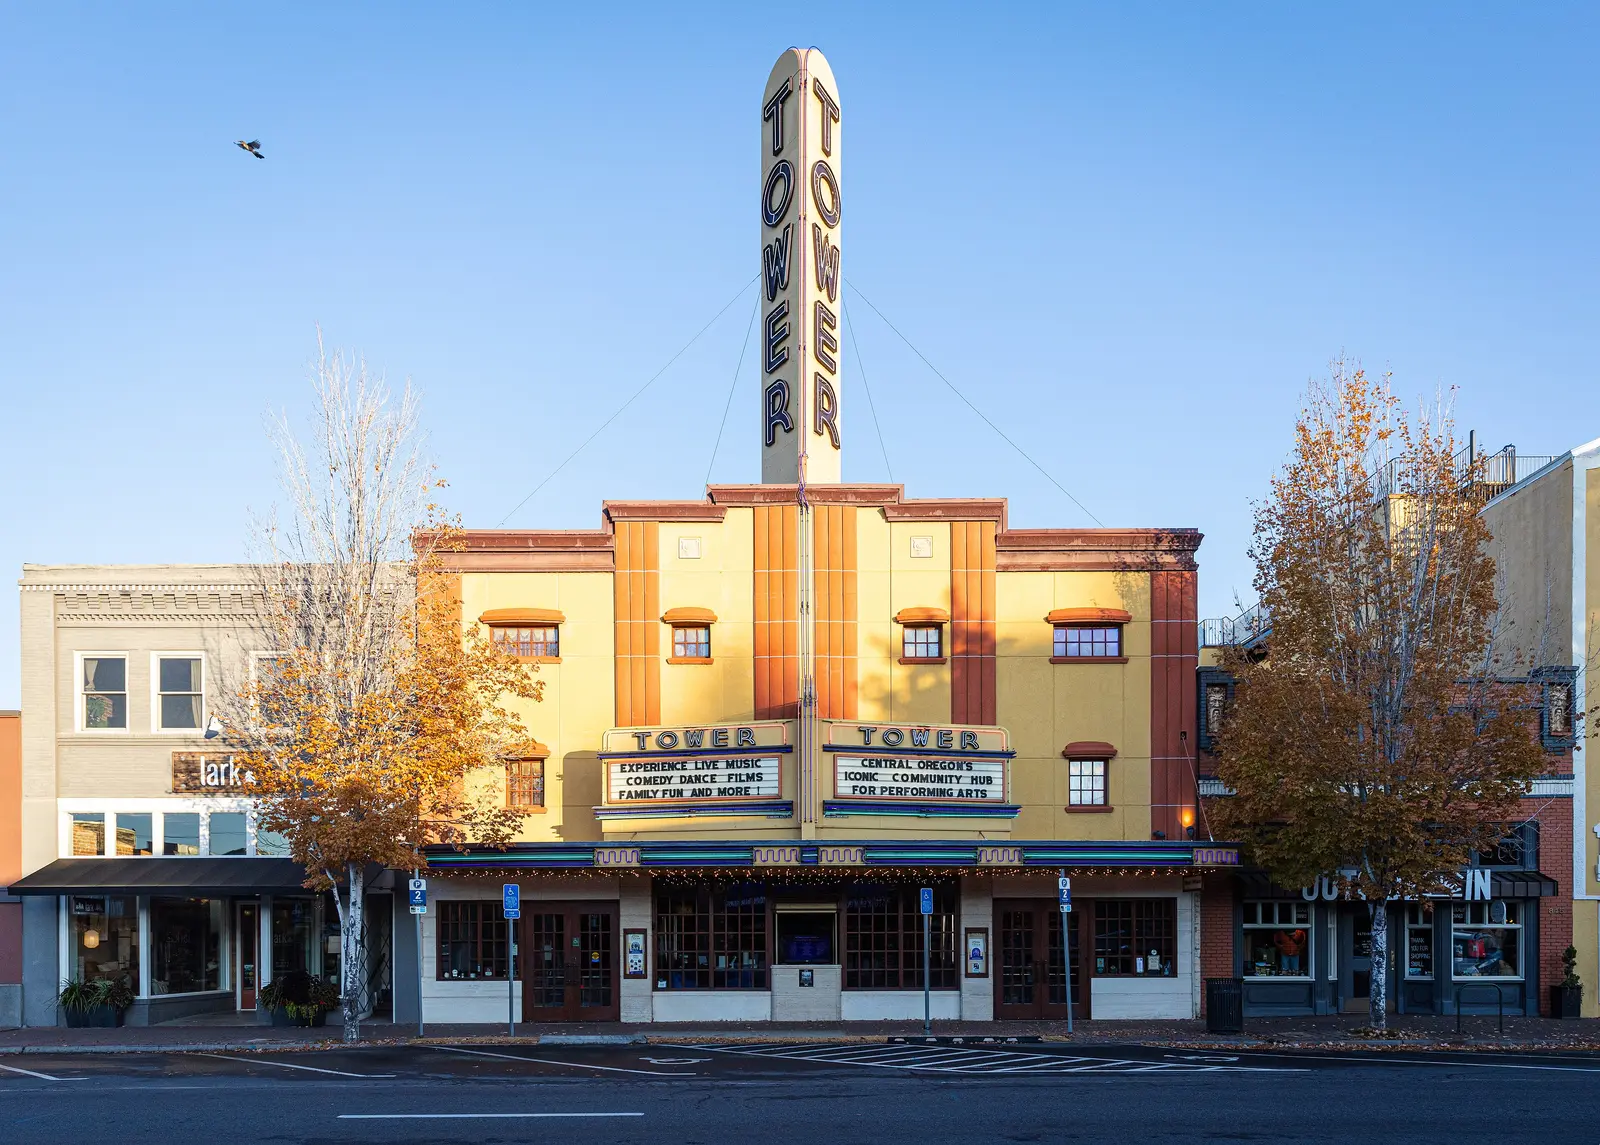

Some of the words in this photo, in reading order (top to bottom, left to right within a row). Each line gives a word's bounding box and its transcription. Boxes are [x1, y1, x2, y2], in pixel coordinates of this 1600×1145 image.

[762, 76, 795, 447] TOWER
[810, 76, 841, 450] TOWER
[634, 727, 756, 750] TOWER
[858, 726, 979, 750] TOWER
[200, 755, 242, 786] lark
[620, 762, 688, 773] EXPERIENCE
[694, 760, 719, 771] LIVE
[725, 758, 762, 770] MUSIC
[861, 758, 913, 769] CENTRAL
[917, 760, 973, 772] OREGON'S
[626, 775, 674, 786] COMEDY
[680, 774, 717, 785] DANCE
[728, 772, 764, 783] FILMS
[844, 771, 879, 782] ICONIC
[892, 773, 963, 785] COMMUNITY
[970, 775, 994, 786] HUB
[619, 789, 660, 800] FAMILY
[662, 788, 684, 799] FUN
[690, 787, 713, 798] AND
[717, 786, 751, 797] MORE
[852, 785, 877, 796] FOR
[880, 786, 954, 798] PERFORMING
[957, 788, 988, 799] ARTS
[1464, 869, 1491, 901] IN
[414, 890, 421, 900] 2
[1062, 889, 1068, 898] 2
